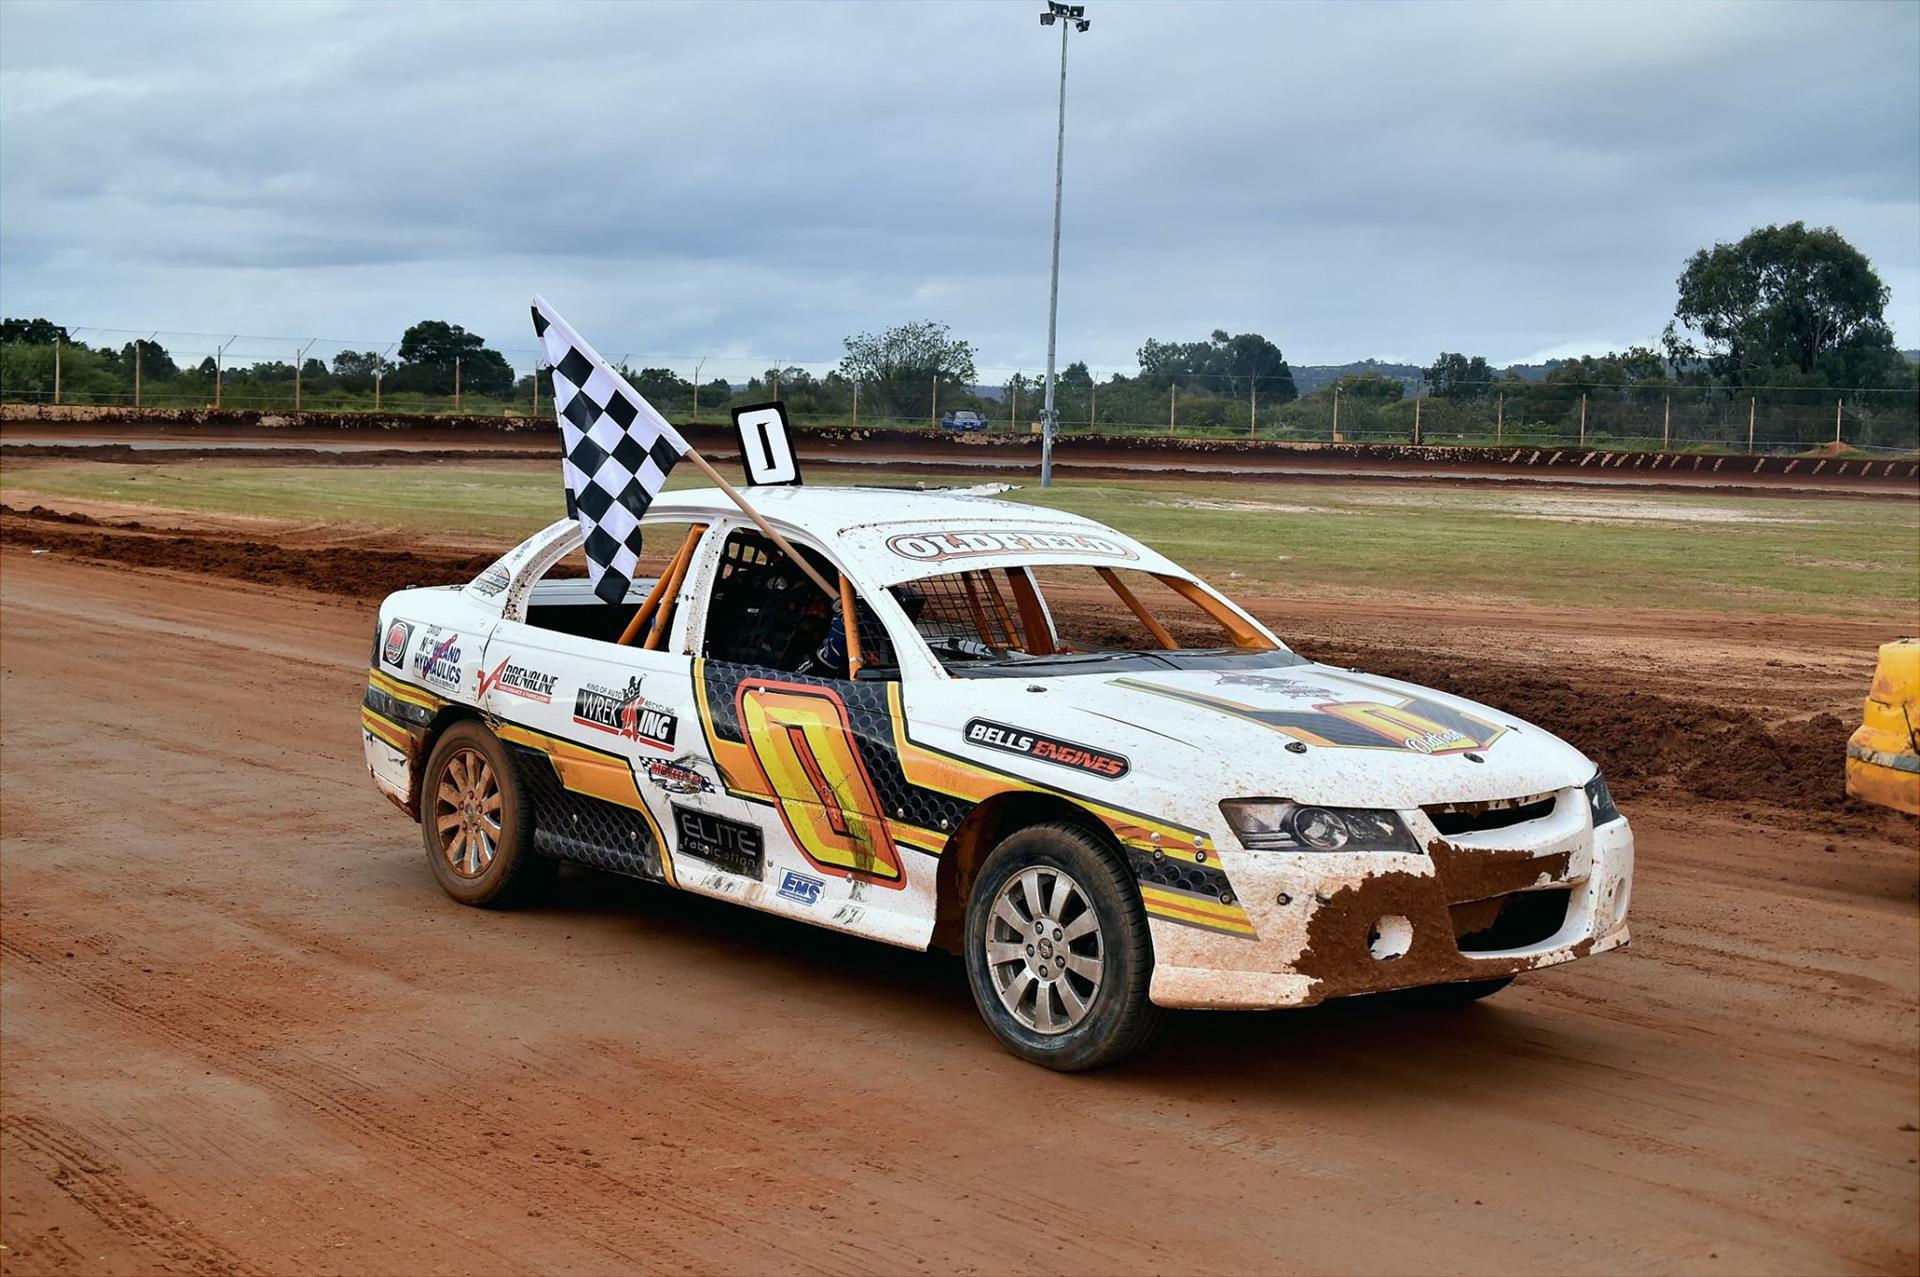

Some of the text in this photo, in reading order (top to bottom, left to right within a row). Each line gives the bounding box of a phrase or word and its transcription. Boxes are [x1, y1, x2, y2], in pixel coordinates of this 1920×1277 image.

[414, 653, 461, 684] HYDAULICS
[477, 655, 558, 701] ADRENALINE
[607, 688, 622, 699] AUTO
[645, 700, 675, 715] RECYCLING
[969, 724, 1124, 775] BELLS ENGINES
[737, 679, 906, 889] 0
[681, 813, 757, 856] ELITE
[684, 837, 756, 868] fabication
[781, 872, 822, 904] EMS
